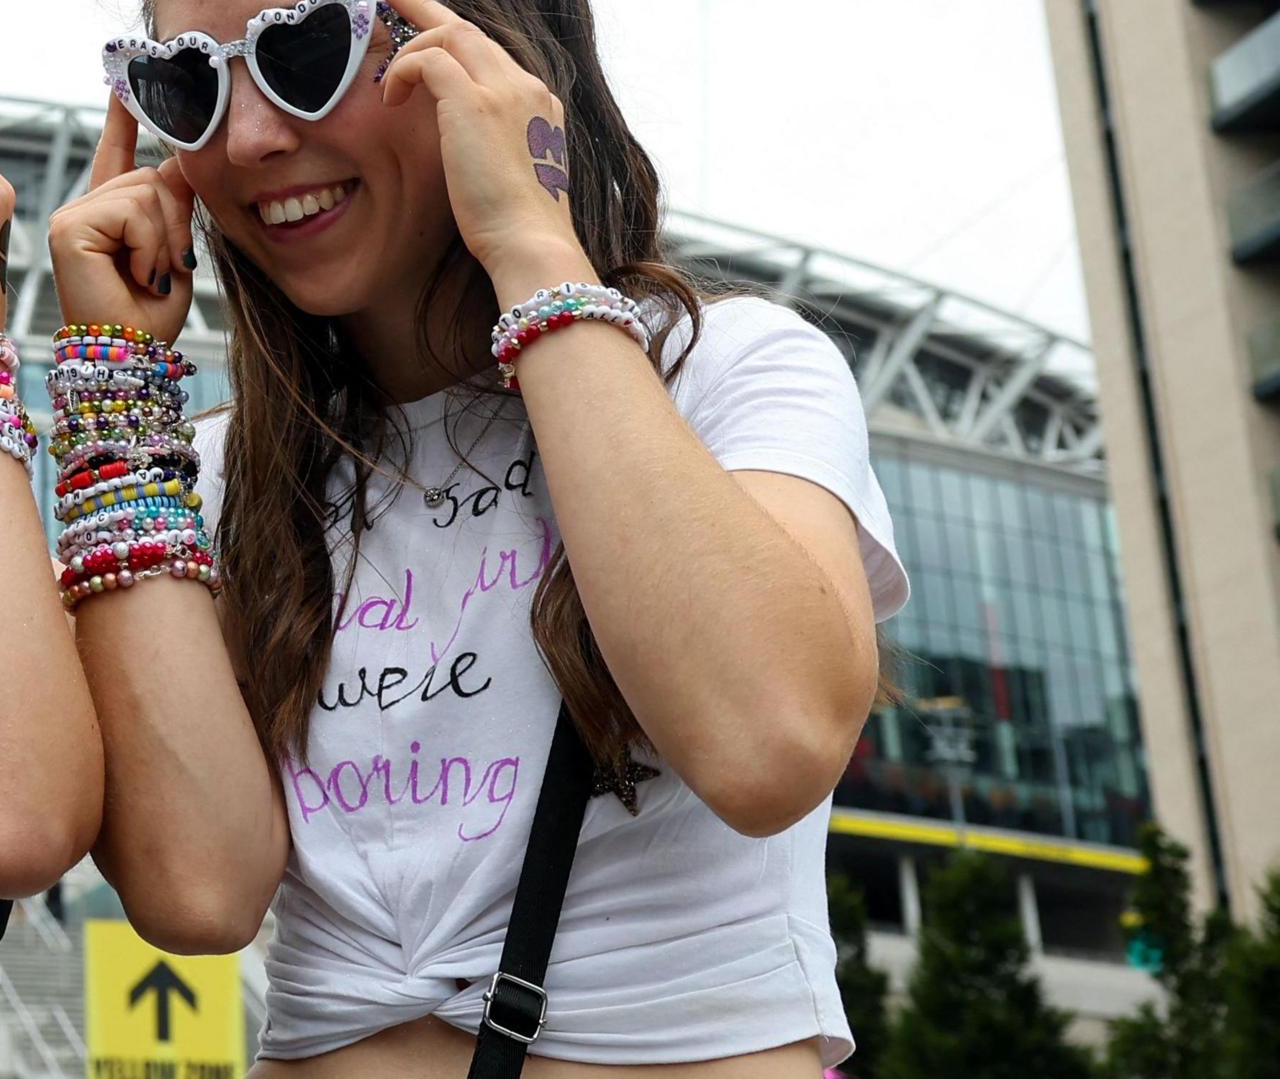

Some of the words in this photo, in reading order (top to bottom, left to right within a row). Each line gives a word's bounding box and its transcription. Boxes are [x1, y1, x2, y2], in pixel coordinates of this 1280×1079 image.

[116, 38, 159, 58] ERAS
[165, 35, 210, 55] TOUR
[316, 651, 492, 713] were
[283, 740, 520, 843] boring
